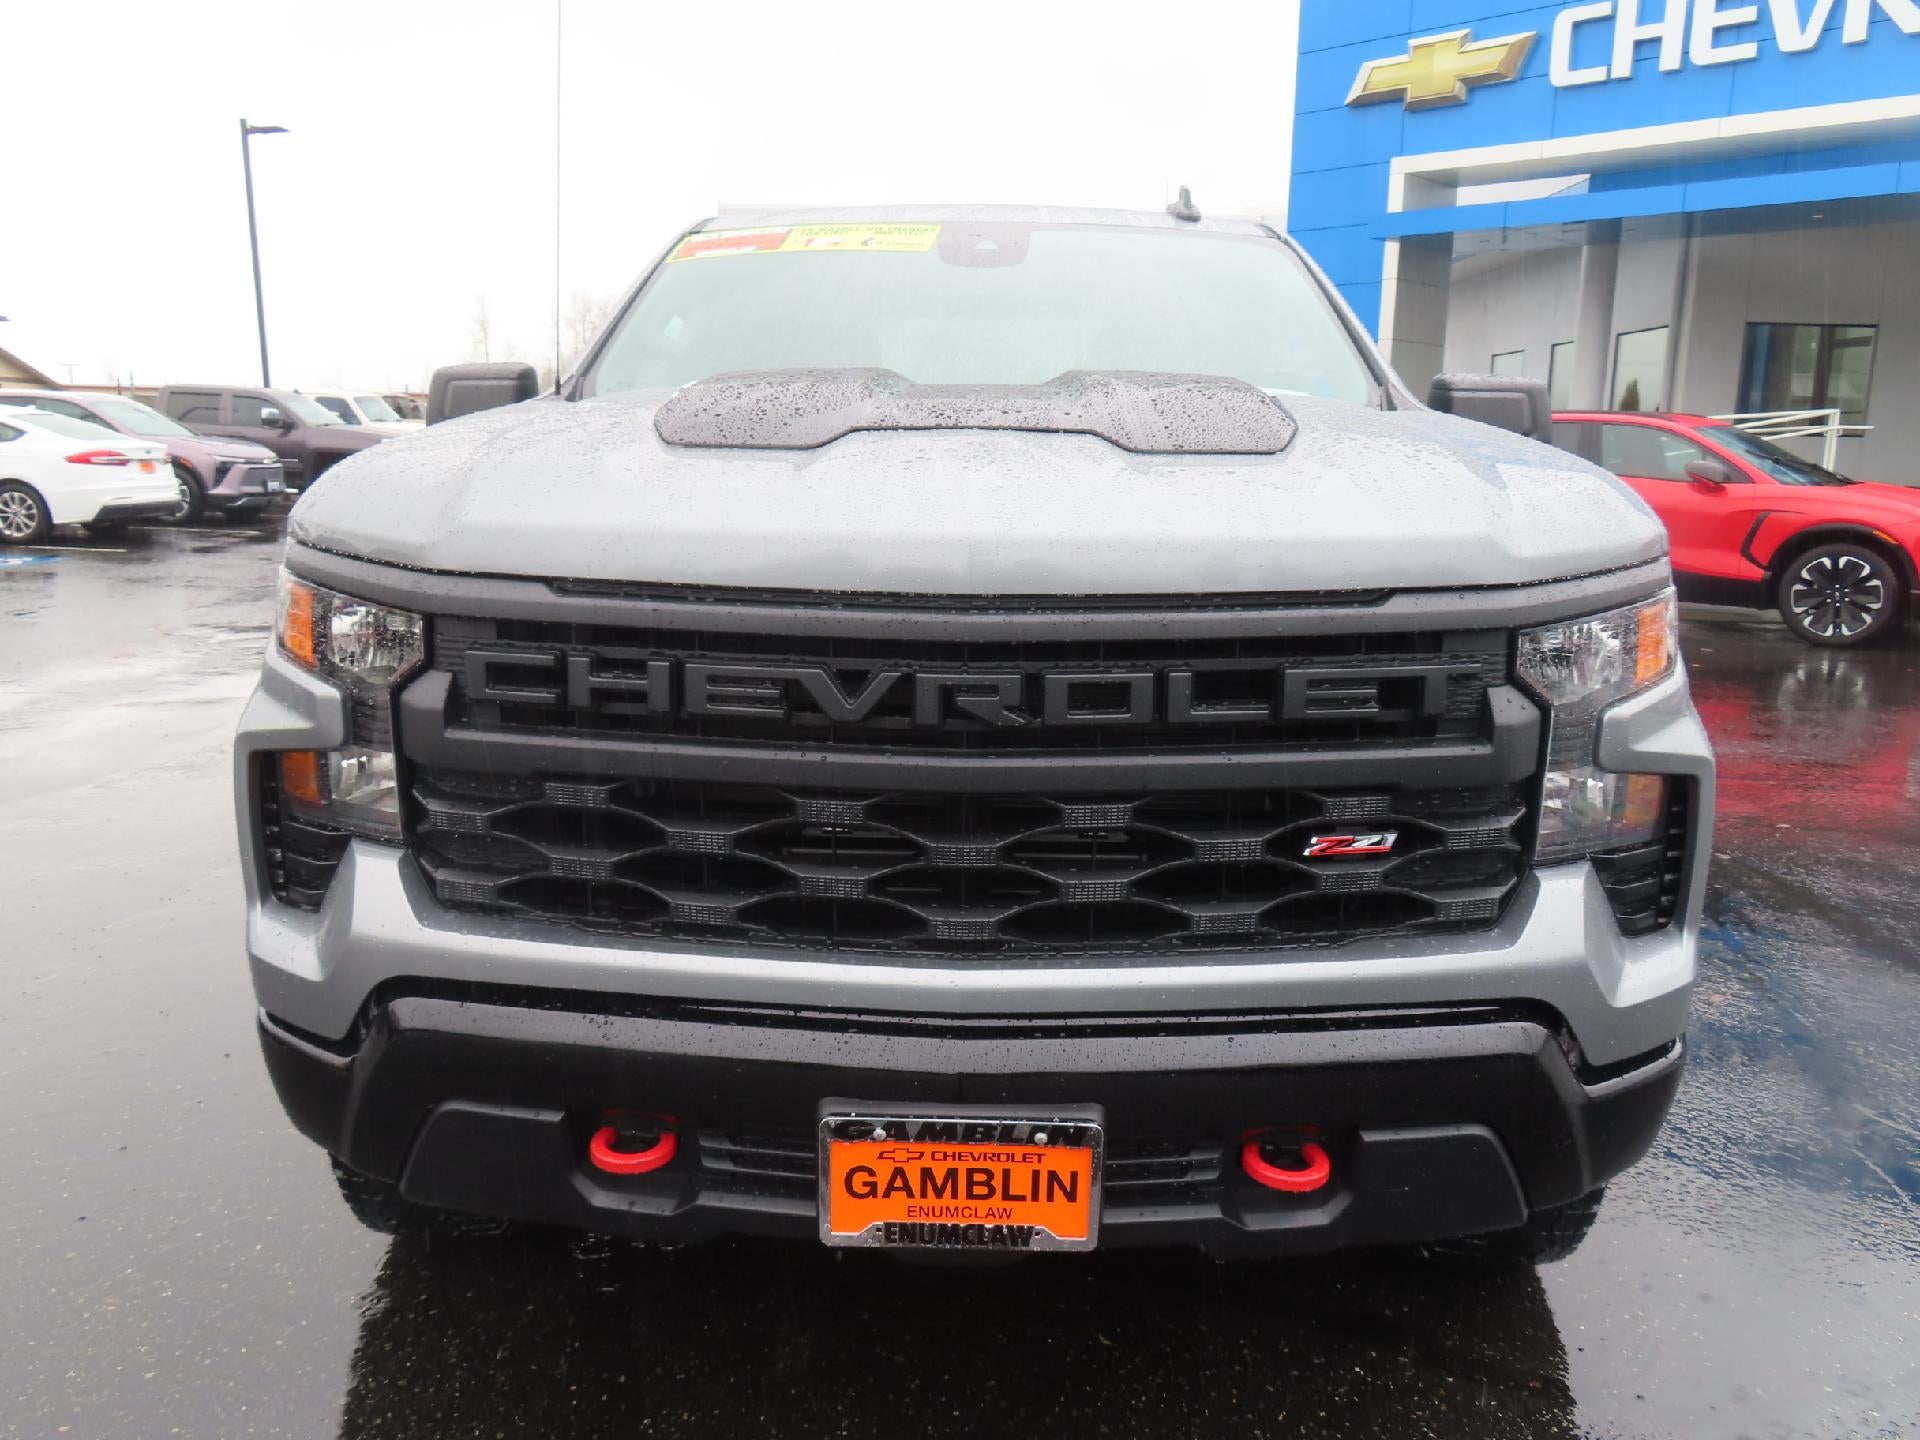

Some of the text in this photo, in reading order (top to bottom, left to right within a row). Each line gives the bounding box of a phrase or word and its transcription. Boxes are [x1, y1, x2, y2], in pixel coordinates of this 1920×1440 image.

[465, 648, 1483, 728] CHEVROLET
[1303, 833, 1398, 856] Z71
[930, 1150, 1046, 1164] CHEVROLET
[843, 1165, 1079, 1203] GAMBLIN
[907, 1205, 1014, 1220] ENUMCLAW
[883, 1222, 1035, 1248] ENUMCLAW
